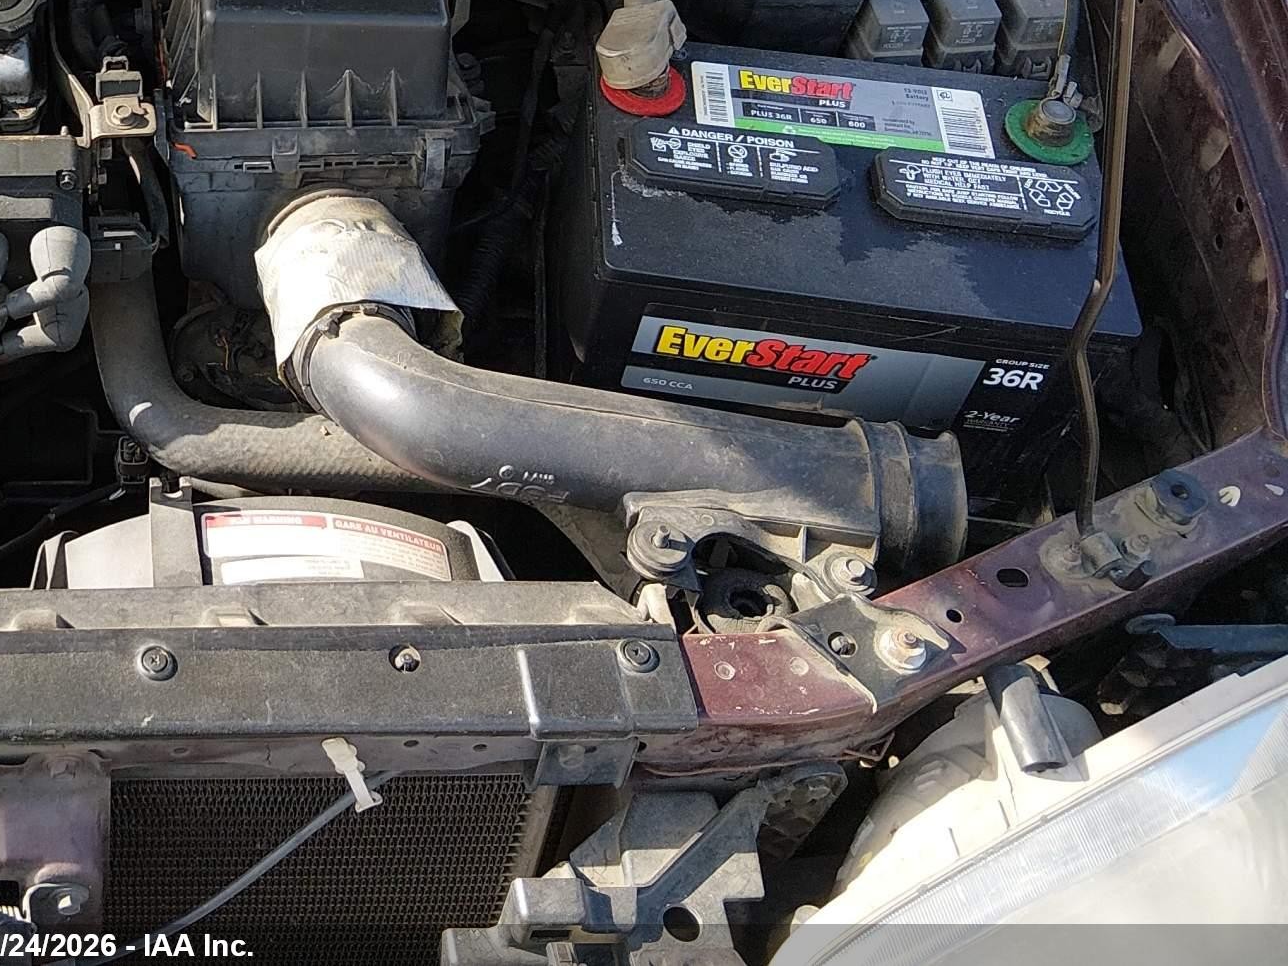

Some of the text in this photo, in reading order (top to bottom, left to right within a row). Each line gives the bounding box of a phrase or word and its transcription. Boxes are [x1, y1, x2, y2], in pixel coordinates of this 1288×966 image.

[739, 70, 853, 100] EverStart
[818, 99, 846, 108] PLUS
[750, 109, 793, 120] PLUS 36R
[681, 128, 734, 142] DANGER
[747, 136, 795, 148] POISON
[656, 325, 871, 380] EverStart
[995, 358, 1050, 370] GROUP SIZE
[643, 377, 693, 390] 650 CCA
[788, 375, 838, 390] PLUS
[982, 367, 1044, 391] 36R
[964, 410, 1021, 423] 2-Year
[364, 523, 378, 534] AU
